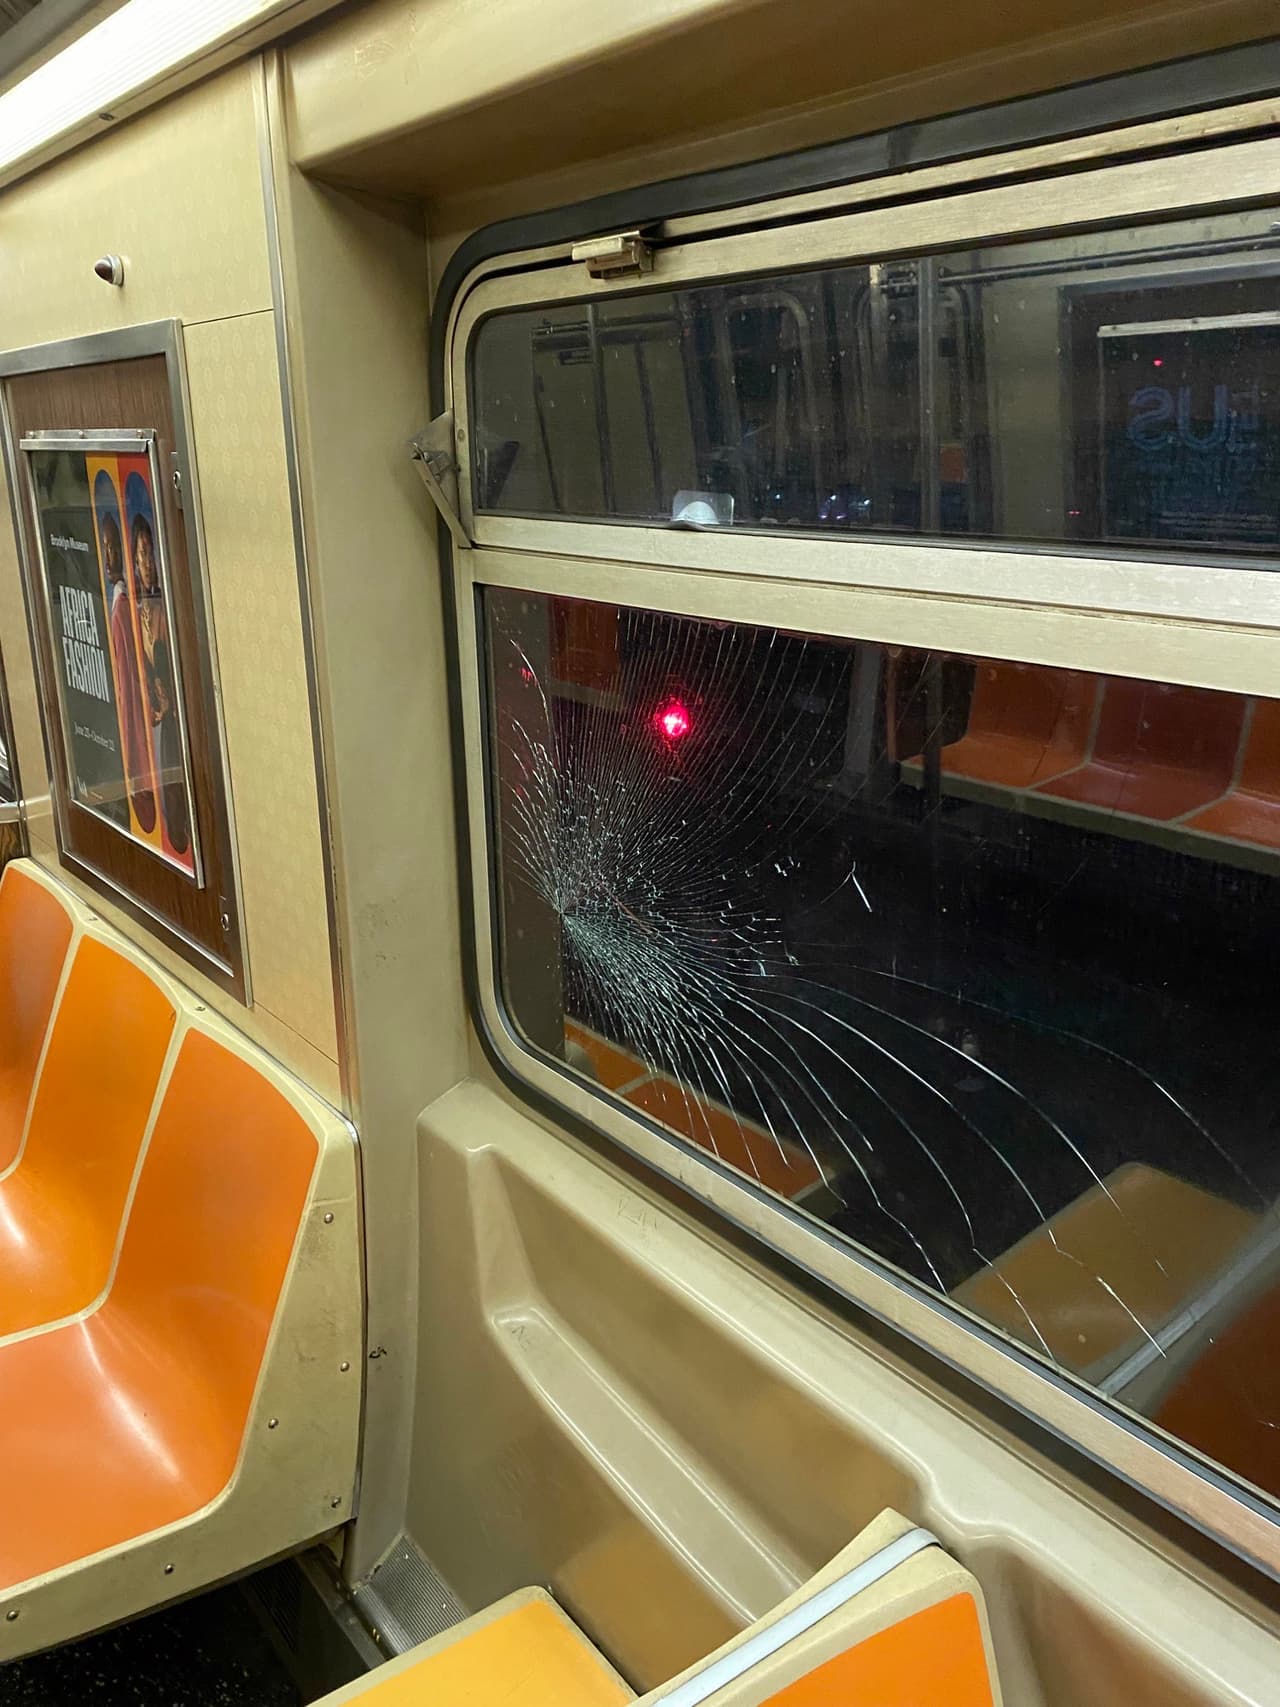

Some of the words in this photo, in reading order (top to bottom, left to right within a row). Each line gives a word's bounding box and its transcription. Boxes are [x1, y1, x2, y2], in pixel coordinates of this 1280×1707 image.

[50, 533, 69, 551] Brooklyn
[69, 536, 89, 552] Museum
[59, 585, 100, 647] AFRICA
[62, 636, 110, 703] FASHION
